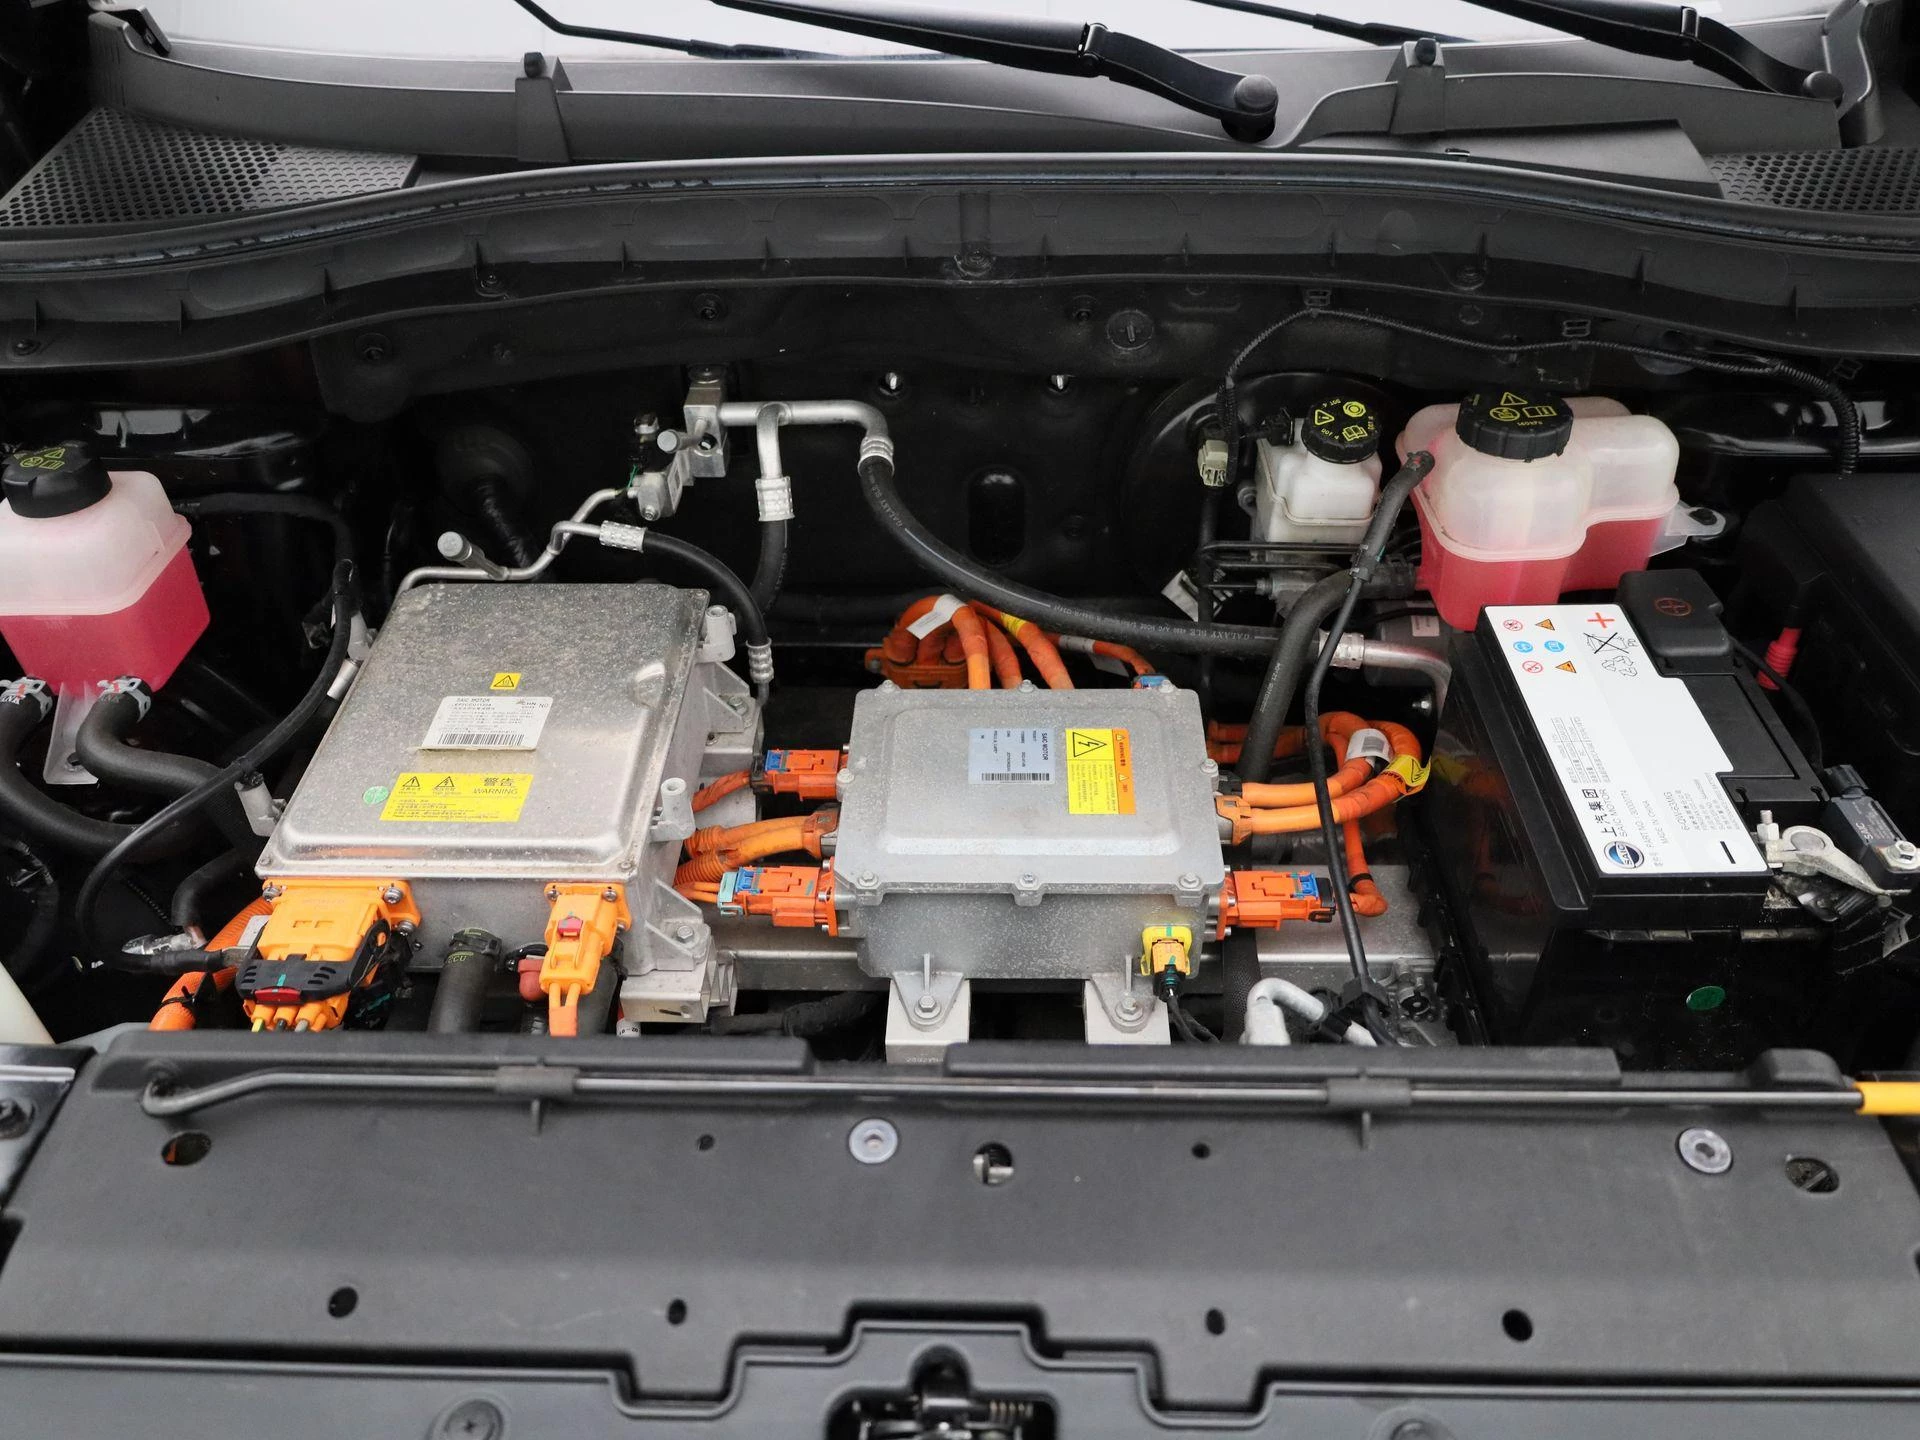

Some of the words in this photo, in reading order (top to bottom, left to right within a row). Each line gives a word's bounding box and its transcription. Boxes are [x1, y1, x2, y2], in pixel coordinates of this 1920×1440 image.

[1210, 629, 1250, 641] GALAXY
[1041, 732, 1049, 743] SAIC
[1041, 744, 1049, 761] MOTOR
[473, 787, 518, 795] WARNING
[1600, 788, 1617, 817] MOTOR
[1581, 788, 1617, 837] 上汽集团
[1617, 844, 1632, 865] SAIC
